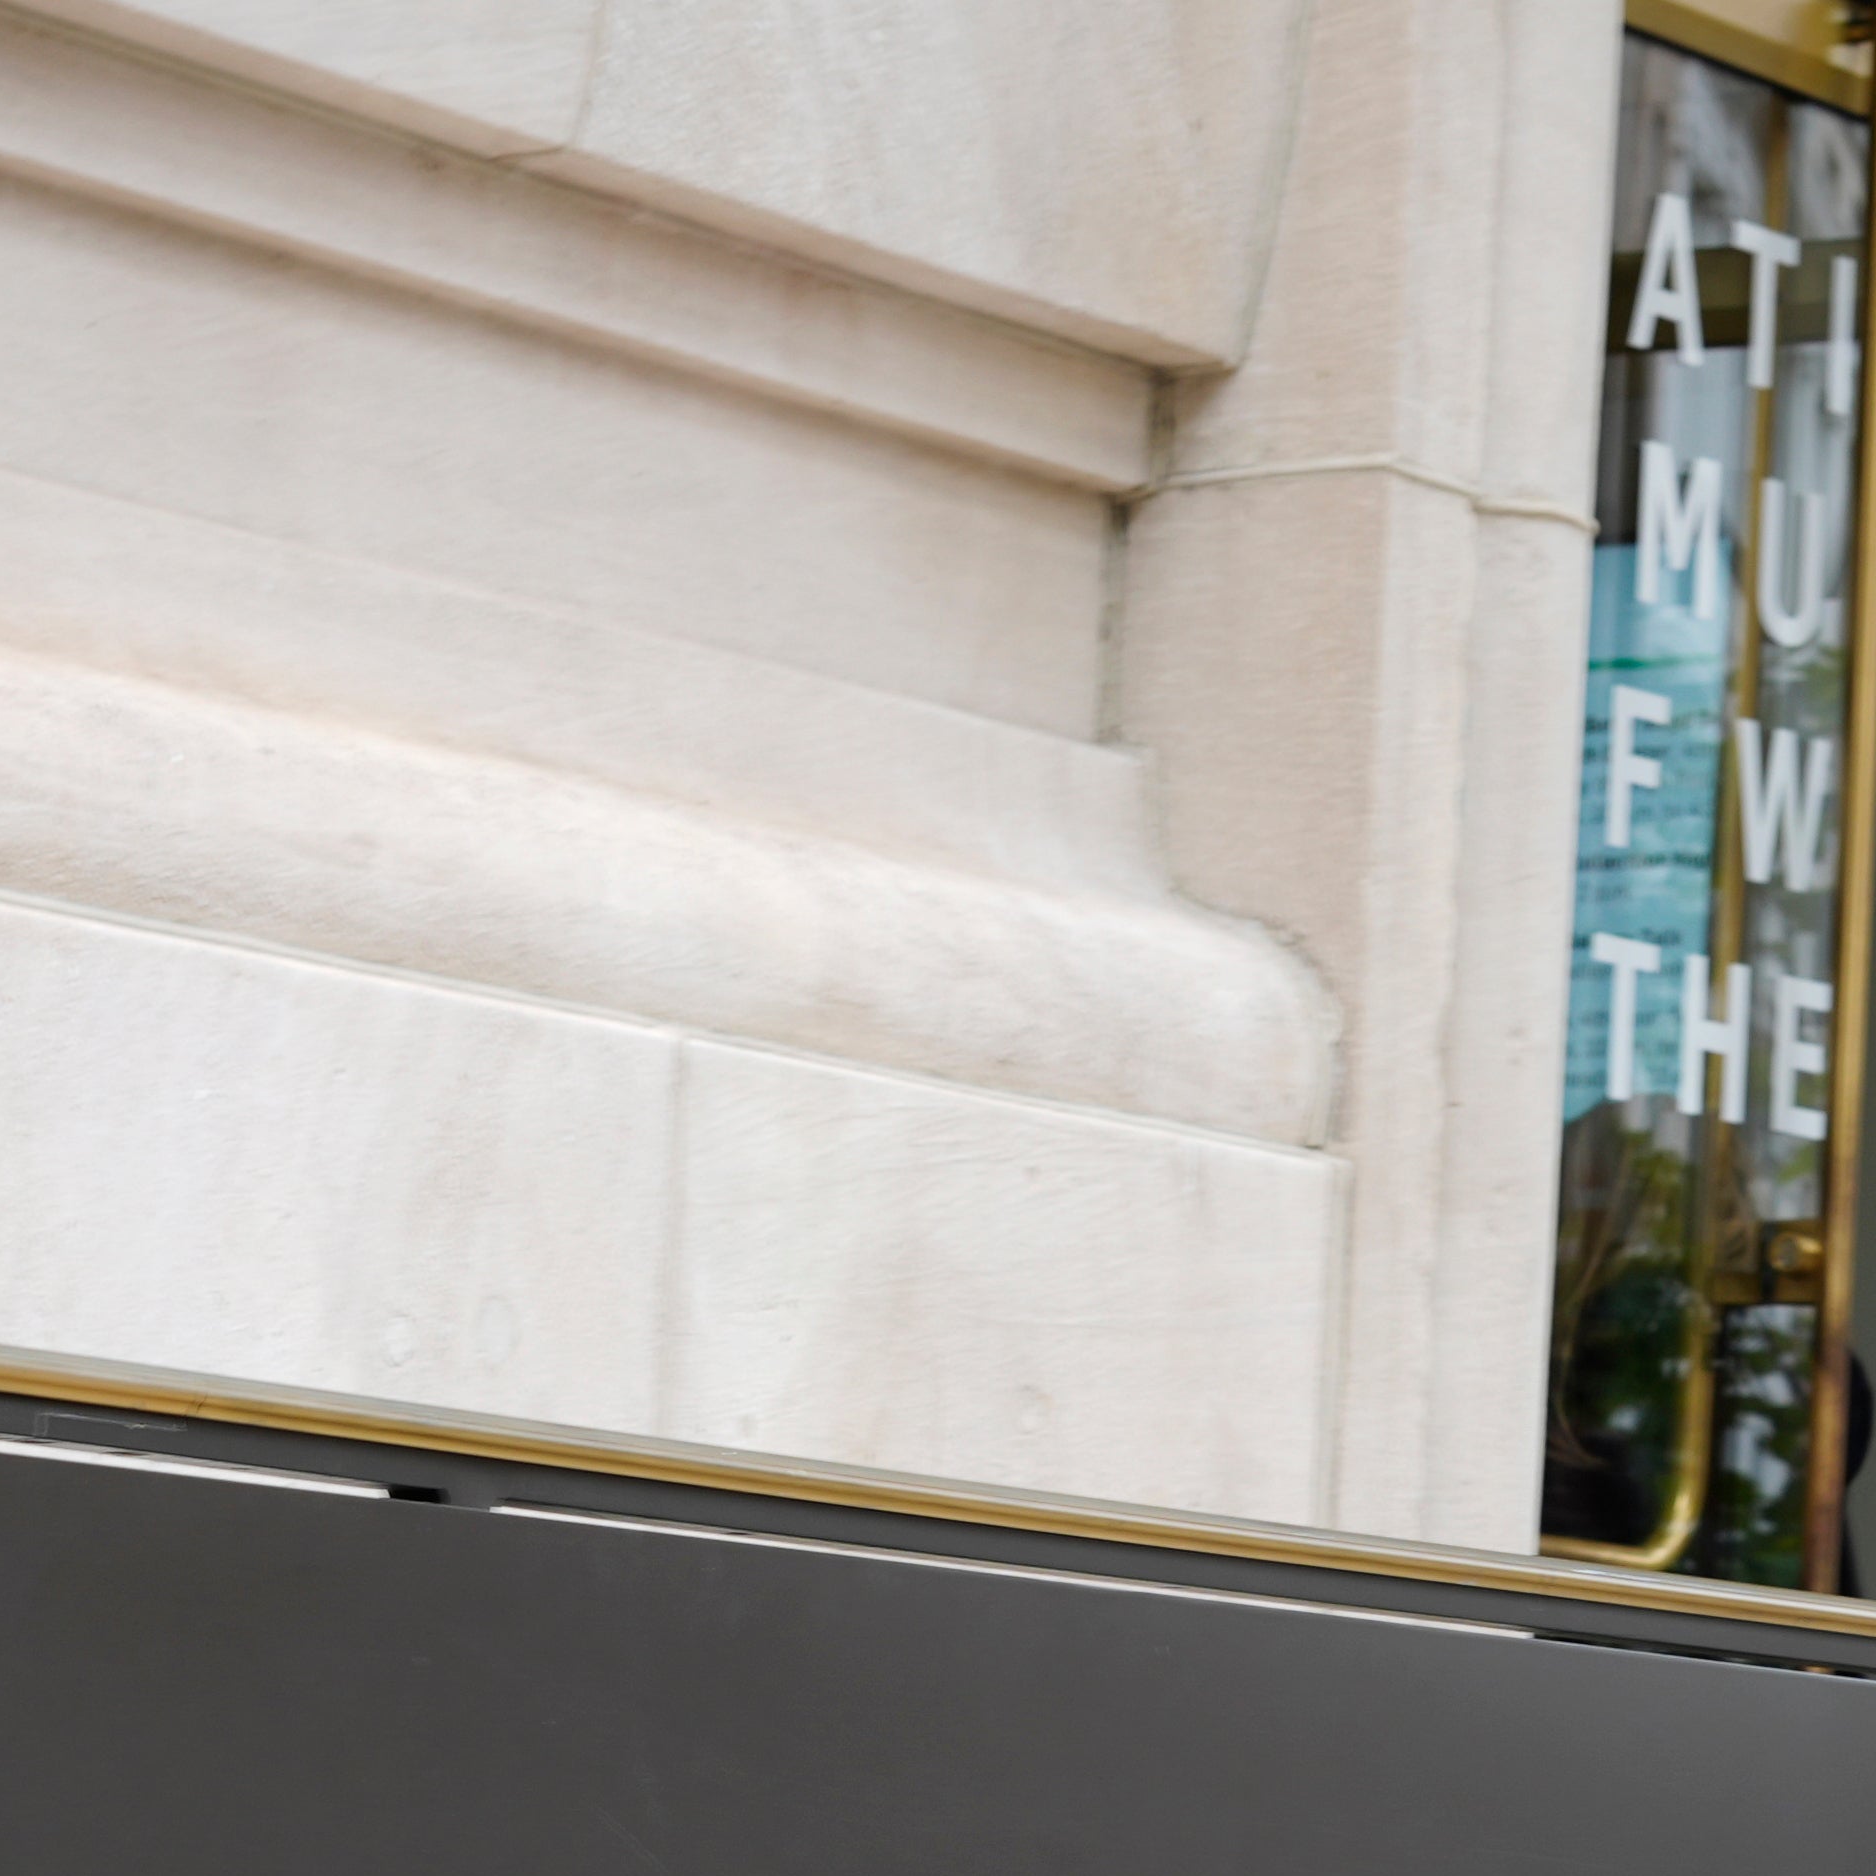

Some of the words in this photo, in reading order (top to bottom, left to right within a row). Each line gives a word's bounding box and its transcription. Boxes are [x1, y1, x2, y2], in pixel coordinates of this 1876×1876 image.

[1627, 193, 1858, 415] ATI
[1635, 440, 1826, 648] MU
[1604, 685, 1670, 848] F
[1736, 717, 1833, 892] W
[1590, 932, 1833, 1141] THE
